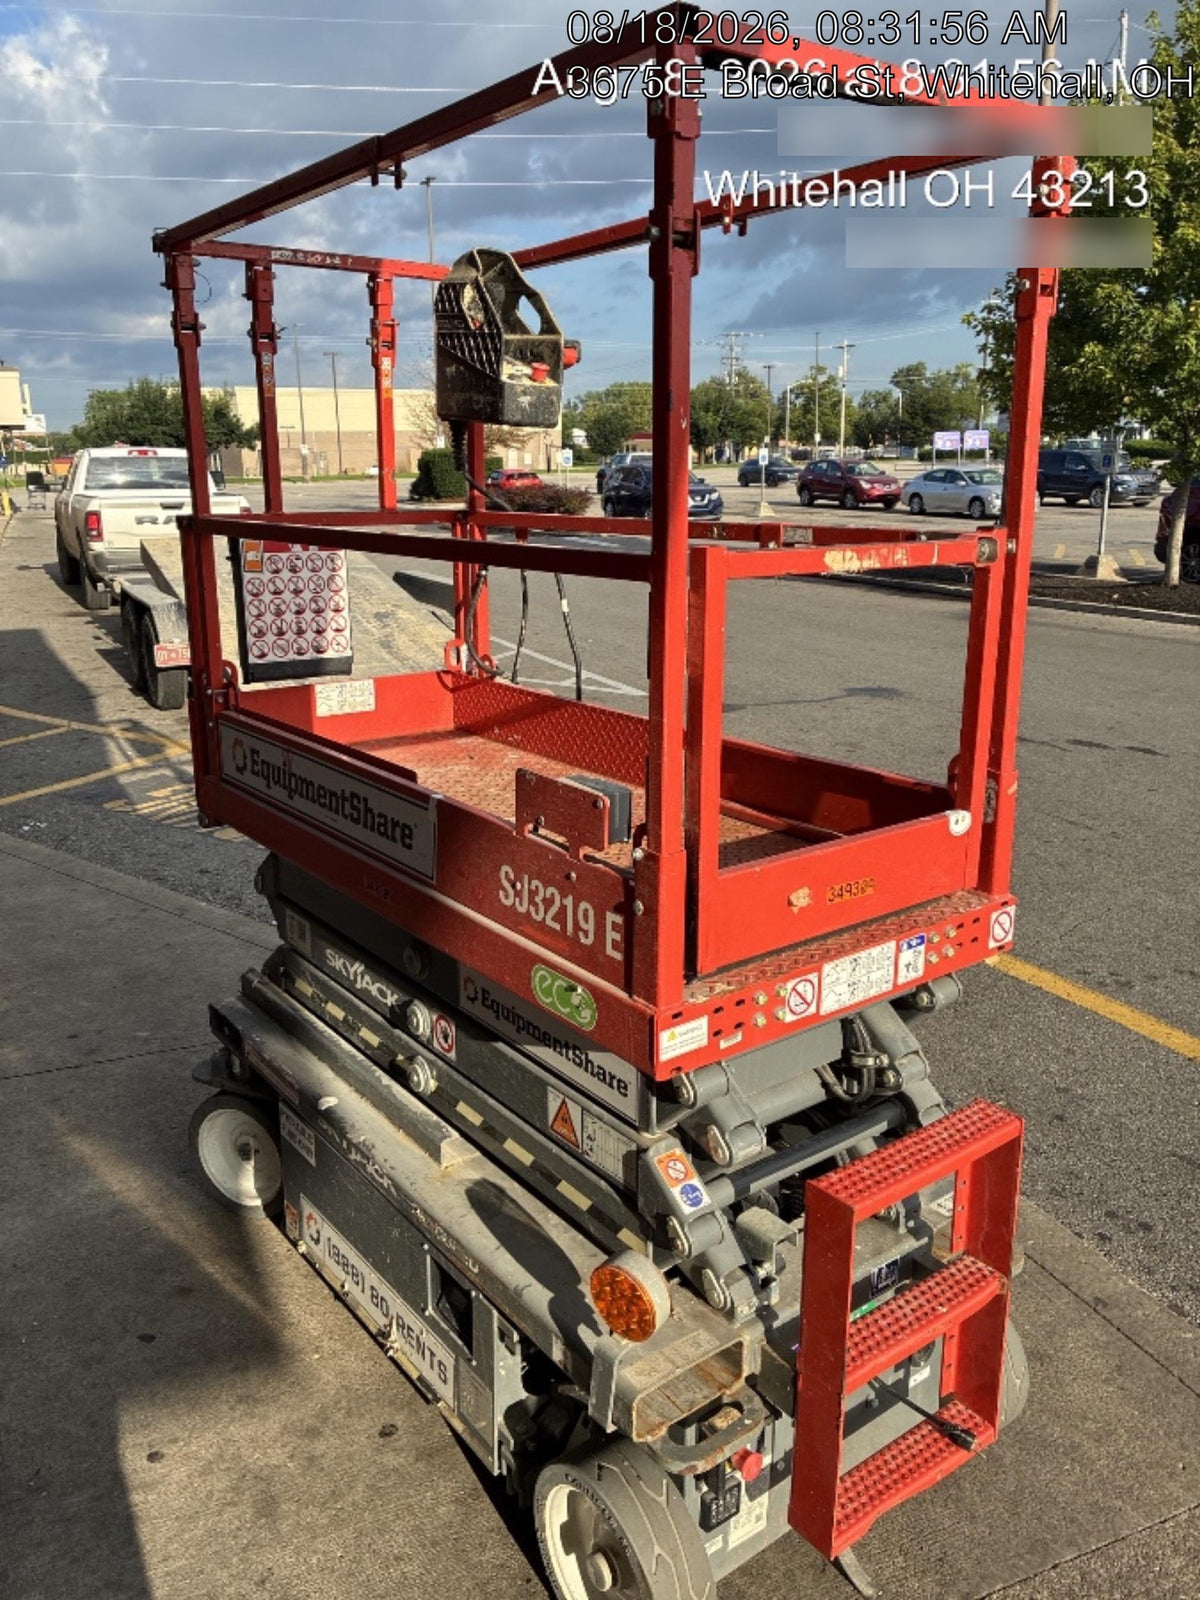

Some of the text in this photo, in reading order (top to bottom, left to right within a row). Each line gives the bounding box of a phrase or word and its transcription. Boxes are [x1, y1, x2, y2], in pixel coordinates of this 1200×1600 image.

[249, 747, 414, 851] EquipmentShare
[499, 864, 624, 961] SJ3219 E
[324, 948, 399, 1007] SKYJACK
[480, 987, 629, 1098] EquipmentShare
[395, 1310, 448, 1386] RENTS
